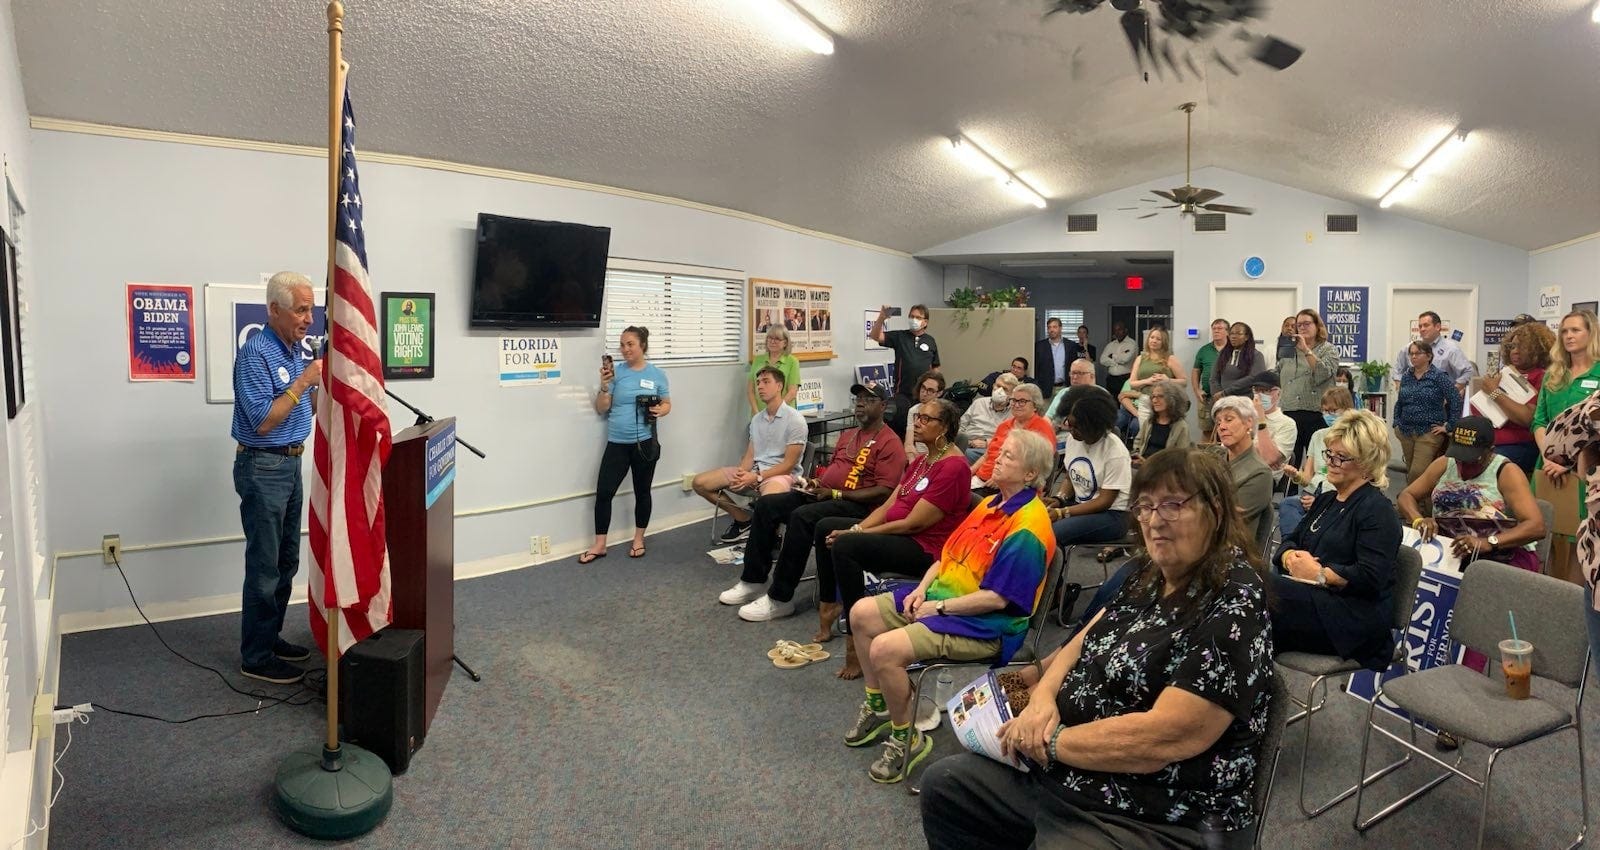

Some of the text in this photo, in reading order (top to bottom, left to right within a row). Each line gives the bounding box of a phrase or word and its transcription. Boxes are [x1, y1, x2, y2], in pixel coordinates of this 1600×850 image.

[755, 286, 780, 298] WANTED
[784, 288, 806, 300] WANTED
[810, 290, 830, 302] WANTED
[1328, 290, 1361, 302] IT ALWAYS
[134, 298, 188, 311] OBAMA
[1327, 302, 1361, 312] SEEMS
[1540, 294, 1560, 308] CRIST
[143, 312, 179, 324] BIDEN
[1327, 314, 1360, 324] IMPOSSIBLE
[393, 324, 424, 332] JOHN LEWIS
[1327, 324, 1360, 334] UNTIL
[393, 332, 424, 346] VOTING
[503, 339, 558, 350] FLORIDA
[1332, 334, 1354, 344] IT IS
[394, 345, 423, 358] RIGHTS
[1334, 345, 1361, 358] ONE.
[505, 352, 557, 365] FOR ALL
[862, 376, 890, 391] CST
[798, 390, 821, 400] FOR ALL
[1455, 427, 1477, 437] ARMY
[429, 438, 446, 461] CHARLIE
[429, 446, 455, 480] FOR GOVERNOR
[1071, 468, 1090, 488] CRIST
[1434, 608, 1454, 668] VERNOR
[1428, 637, 1438, 658] FOR
